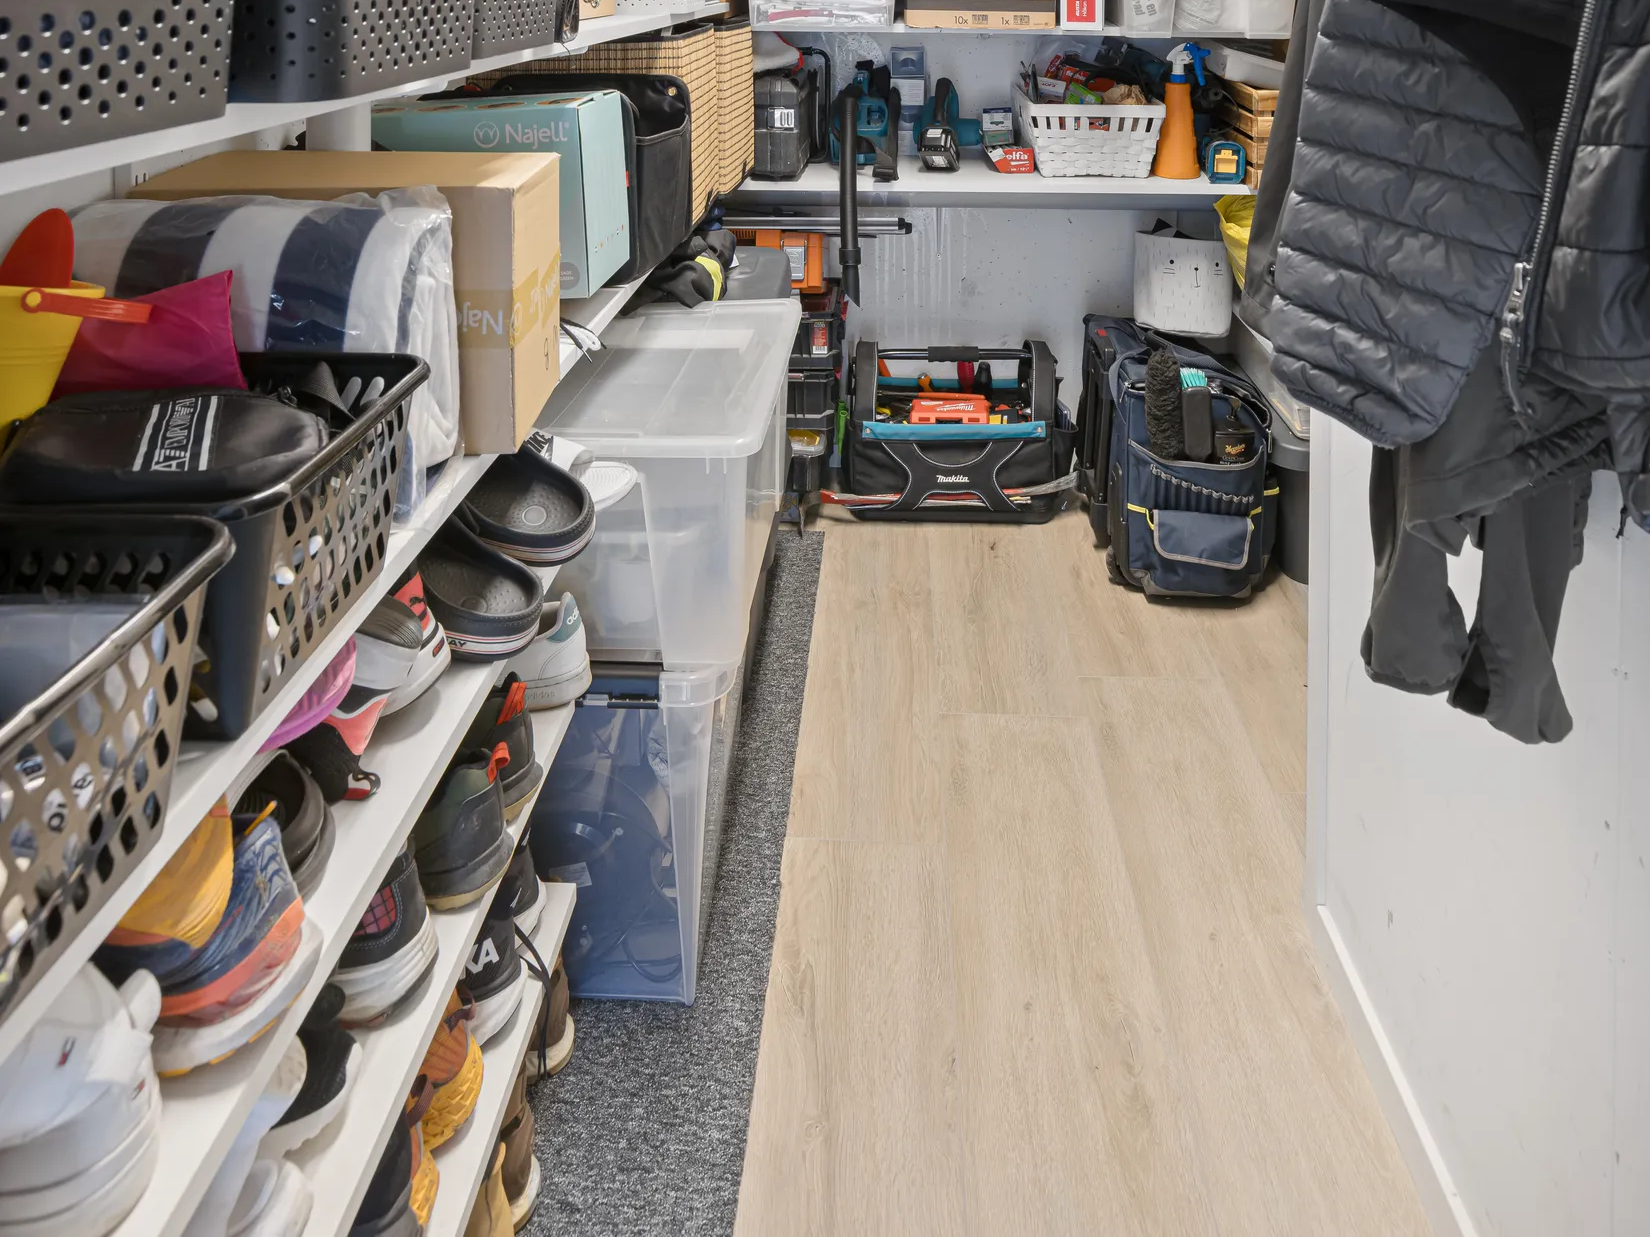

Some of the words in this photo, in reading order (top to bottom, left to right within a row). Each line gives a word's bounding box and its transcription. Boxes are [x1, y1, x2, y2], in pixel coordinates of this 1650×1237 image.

[1145, 3, 1157, 16] en
[954, 16, 969, 24] 10x
[1001, 17, 1010, 25] 1x
[1006, 151, 1029, 160] elfa
